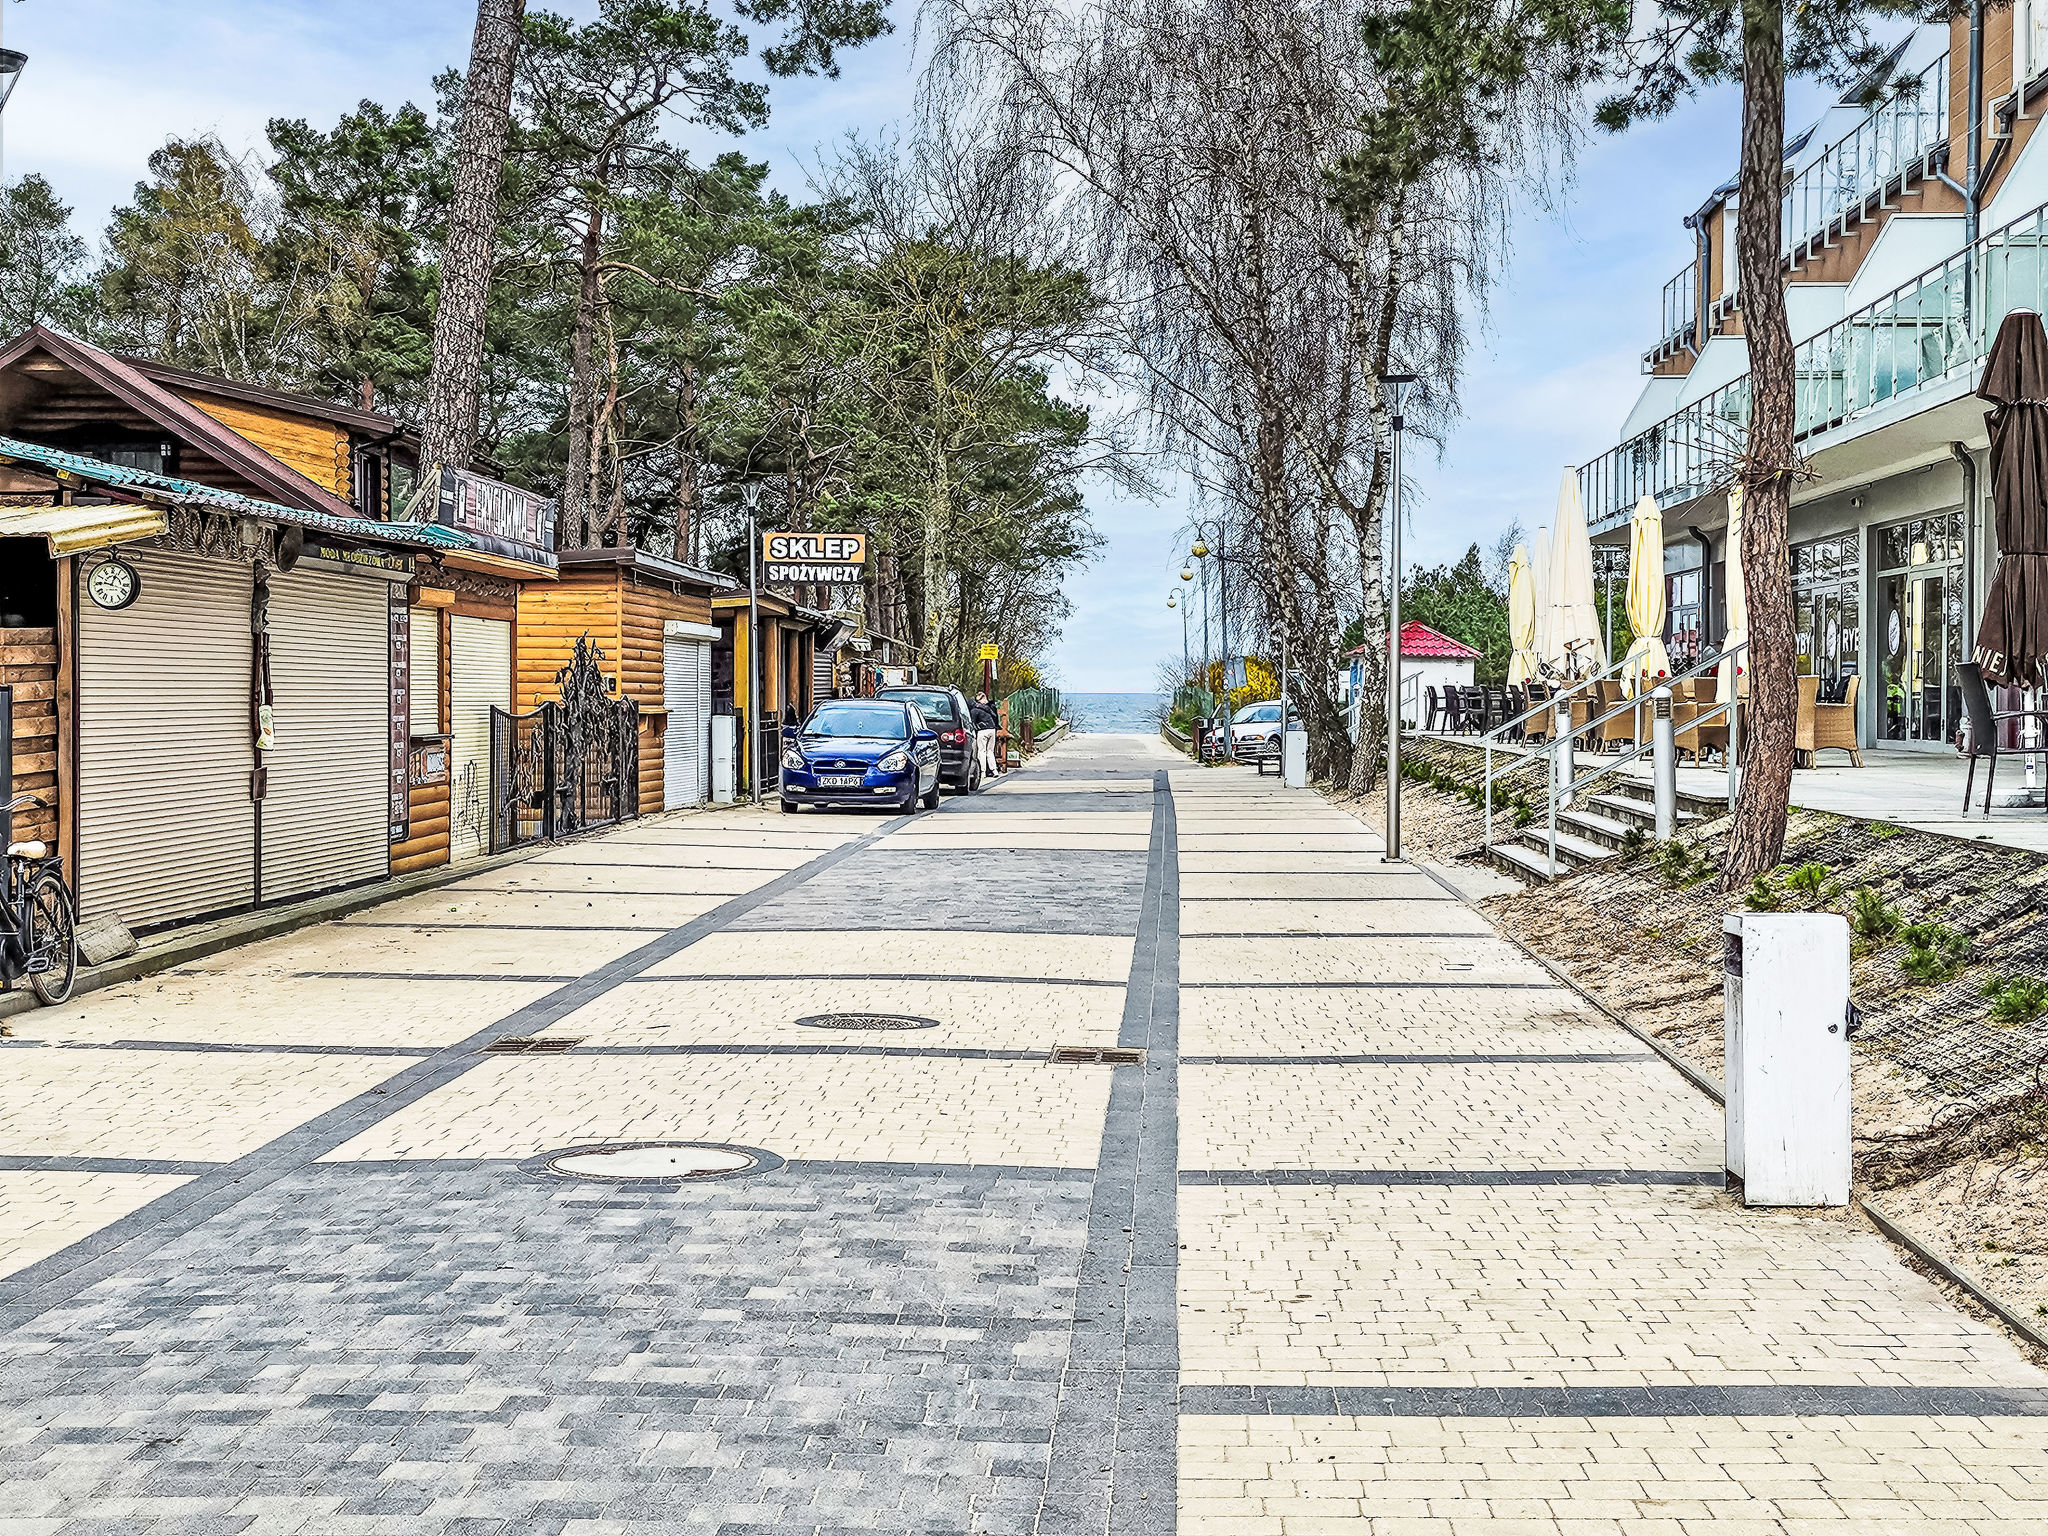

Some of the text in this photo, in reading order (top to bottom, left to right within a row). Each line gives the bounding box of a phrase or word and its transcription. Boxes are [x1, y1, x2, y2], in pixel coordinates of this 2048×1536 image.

[770, 537, 860, 560] SKLEP
[769, 564, 860, 582] SPOŻYWCZY
[1795, 631, 1812, 655] YBY
